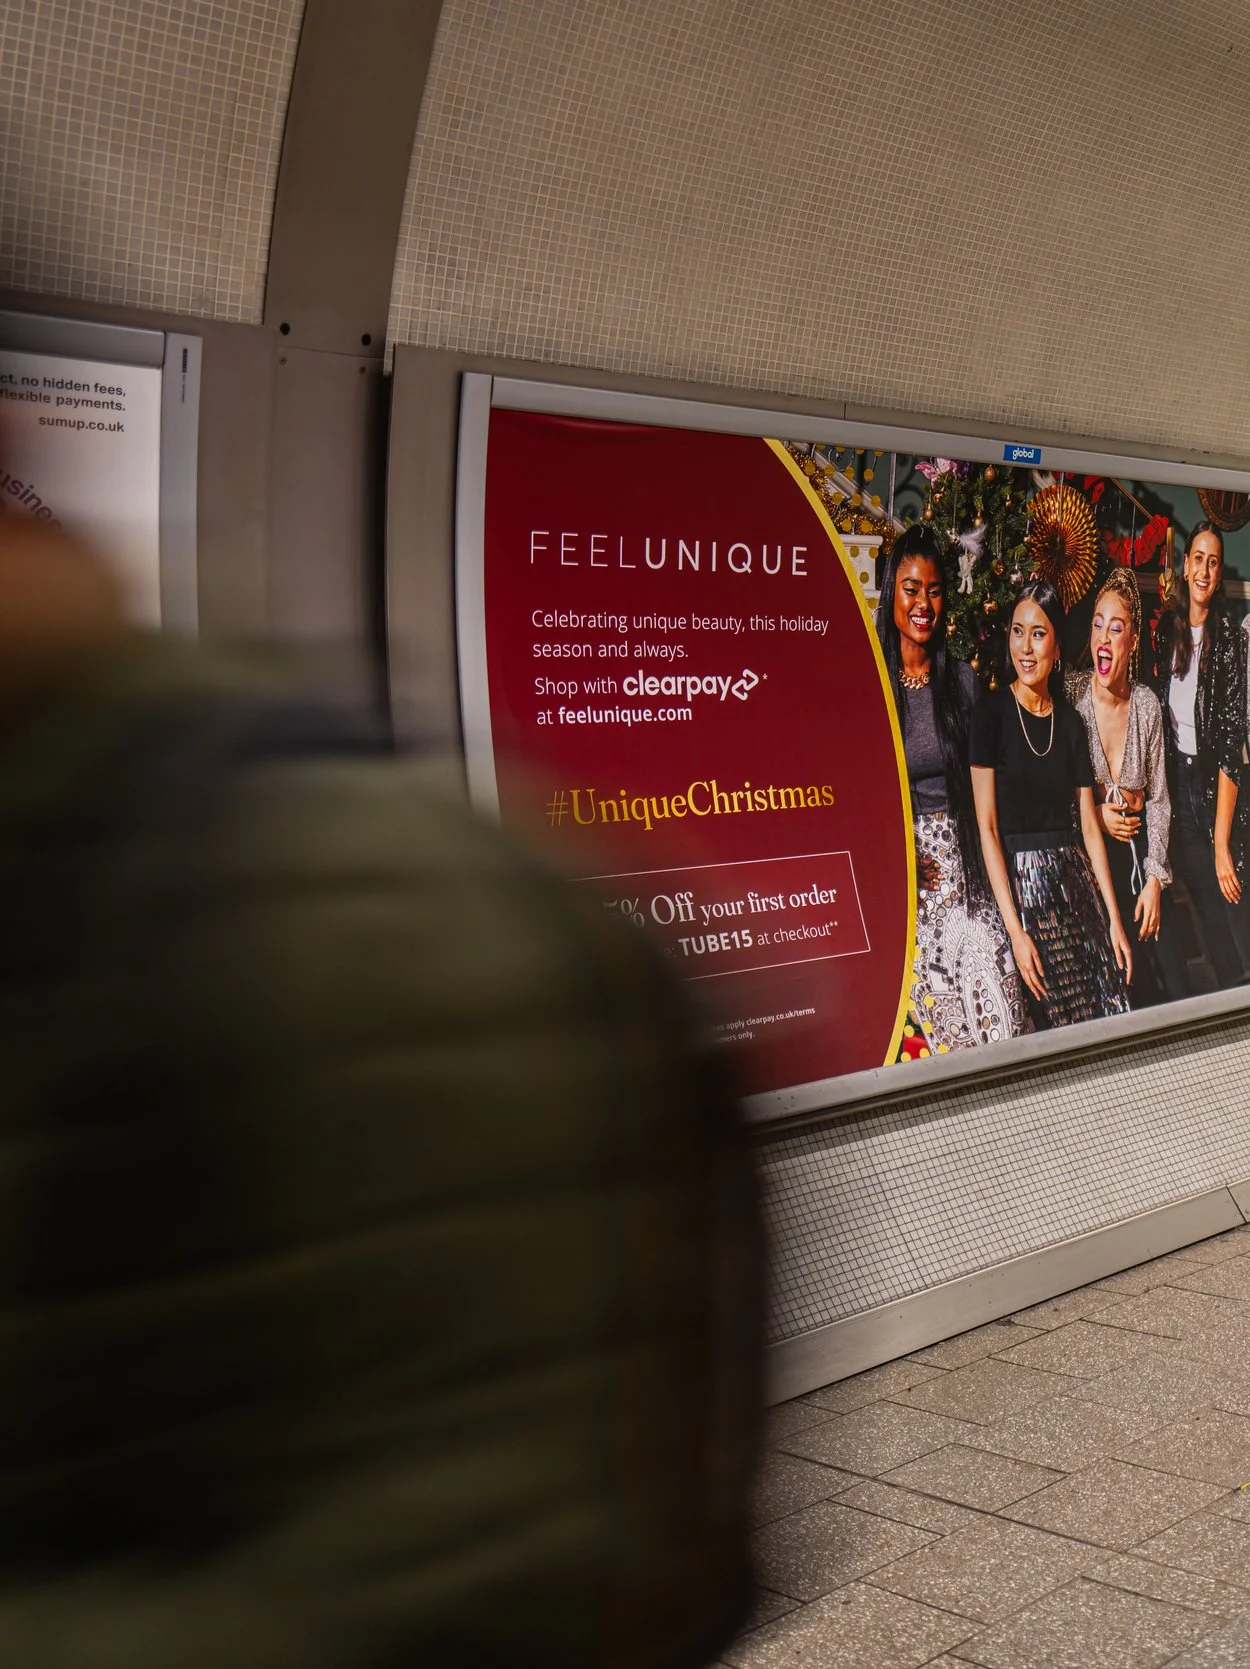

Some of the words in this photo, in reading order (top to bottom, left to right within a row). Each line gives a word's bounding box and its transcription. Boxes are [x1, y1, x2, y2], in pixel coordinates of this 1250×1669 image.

[21, 376, 39, 387] no
[43, 376, 90, 392] hidden
[94, 382, 126, 397] fees,
[56, 396, 126, 411] payments.
[38, 416, 125, 432] sumup.co.uk
[1012, 448, 1035, 460] global
[530, 530, 808, 577] FEELUNIQUE
[532, 610, 628, 633] Celebrating
[633, 612, 687, 633] unique
[692, 613, 746, 633] beauty,
[750, 615, 775, 631] this
[780, 616, 829, 635] holiday
[533, 642, 592, 658] season
[598, 641, 628, 658] and
[634, 641, 688, 662] always.
[535, 677, 578, 698] Shop
[583, 677, 617, 695] with
[622, 669, 732, 701] clearpay
[537, 708, 553, 725] at
[558, 705, 693, 727] feelunique.com
[546, 779, 835, 831] #UniqueChristmas
[651, 891, 696, 925] Off
[701, 898, 745, 926] your
[748, 891, 786, 914] first
[789, 883, 837, 908] order
[678, 929, 753, 957] TUBE15
[757, 932, 770, 946] at
[726, 1020, 745, 1032] apply
[746, 1007, 816, 1025] clearpay.co.uk/terms
[738, 1031, 755, 1040] only.
